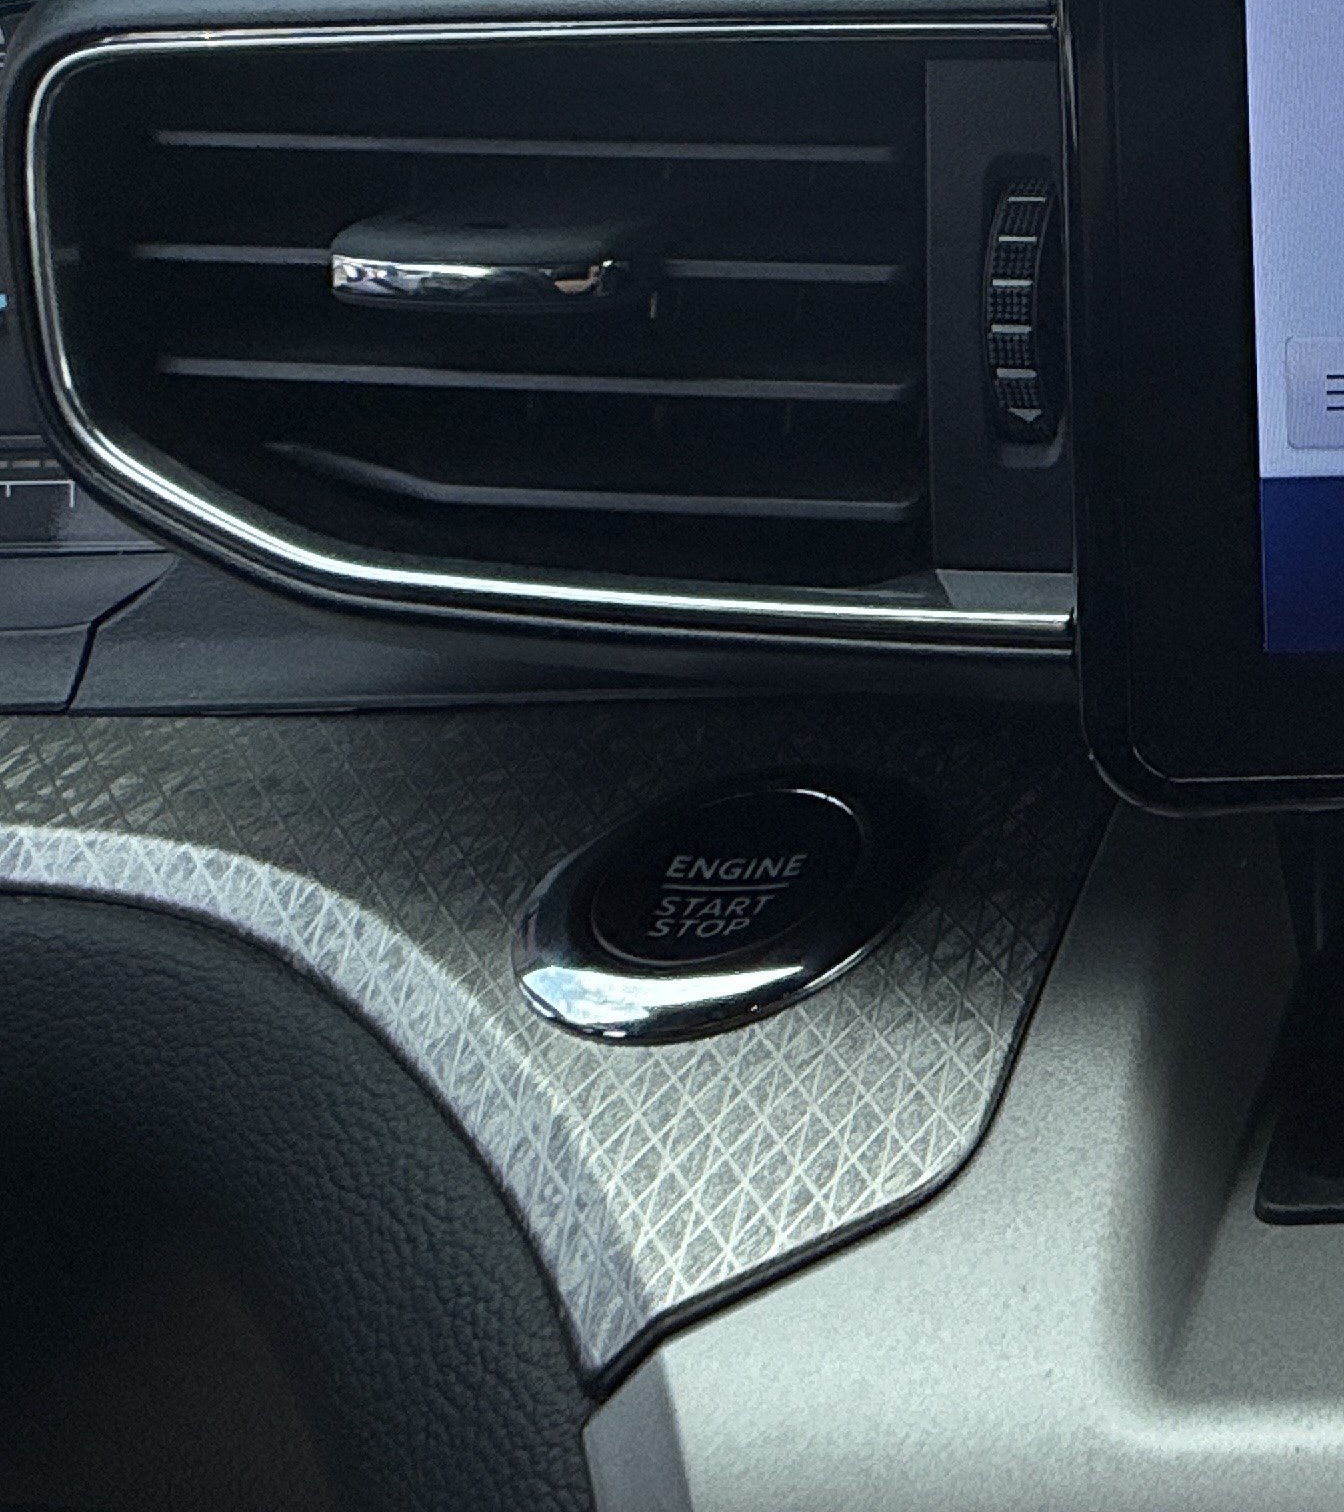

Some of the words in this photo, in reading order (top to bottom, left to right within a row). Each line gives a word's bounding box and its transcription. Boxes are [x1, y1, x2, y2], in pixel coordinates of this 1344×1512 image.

[665, 854, 807, 879] ENGINE
[652, 894, 775, 918] START
[646, 918, 751, 938] STOP
